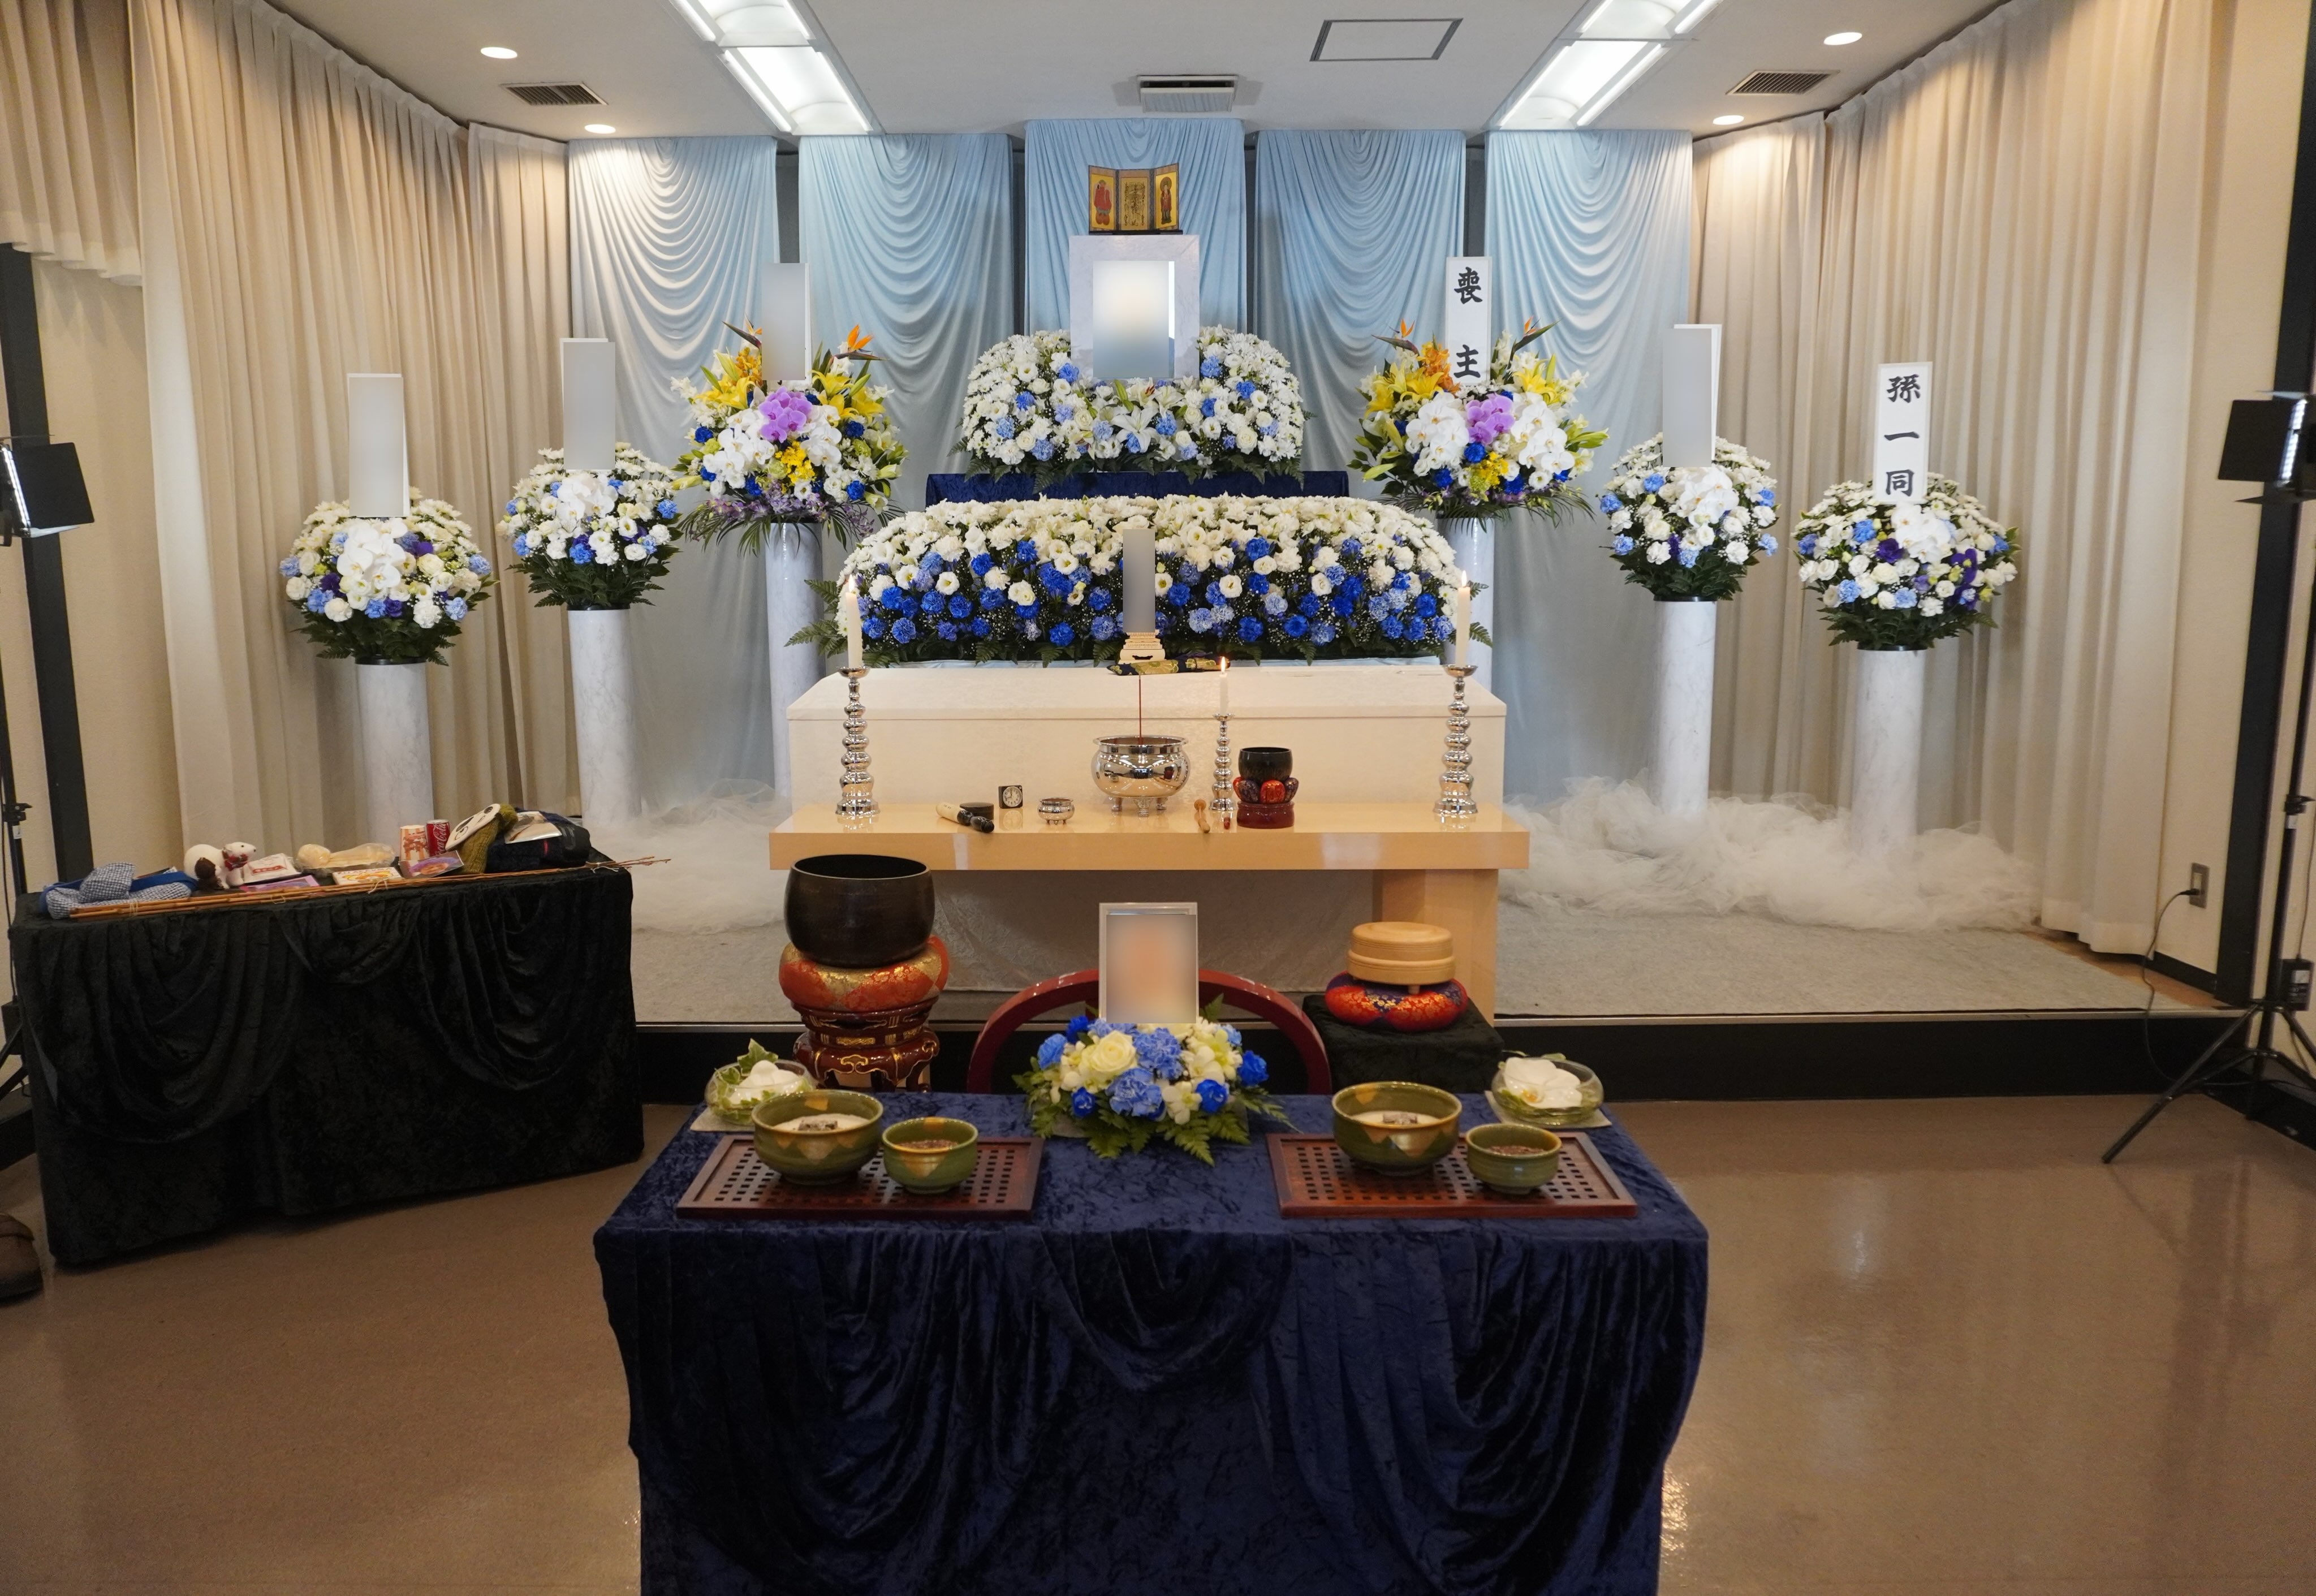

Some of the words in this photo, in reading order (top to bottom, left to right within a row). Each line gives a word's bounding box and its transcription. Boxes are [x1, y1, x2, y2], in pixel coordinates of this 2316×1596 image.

[1453, 266, 1483, 378] 喪主
[1883, 374, 1921, 497] 孫一同
